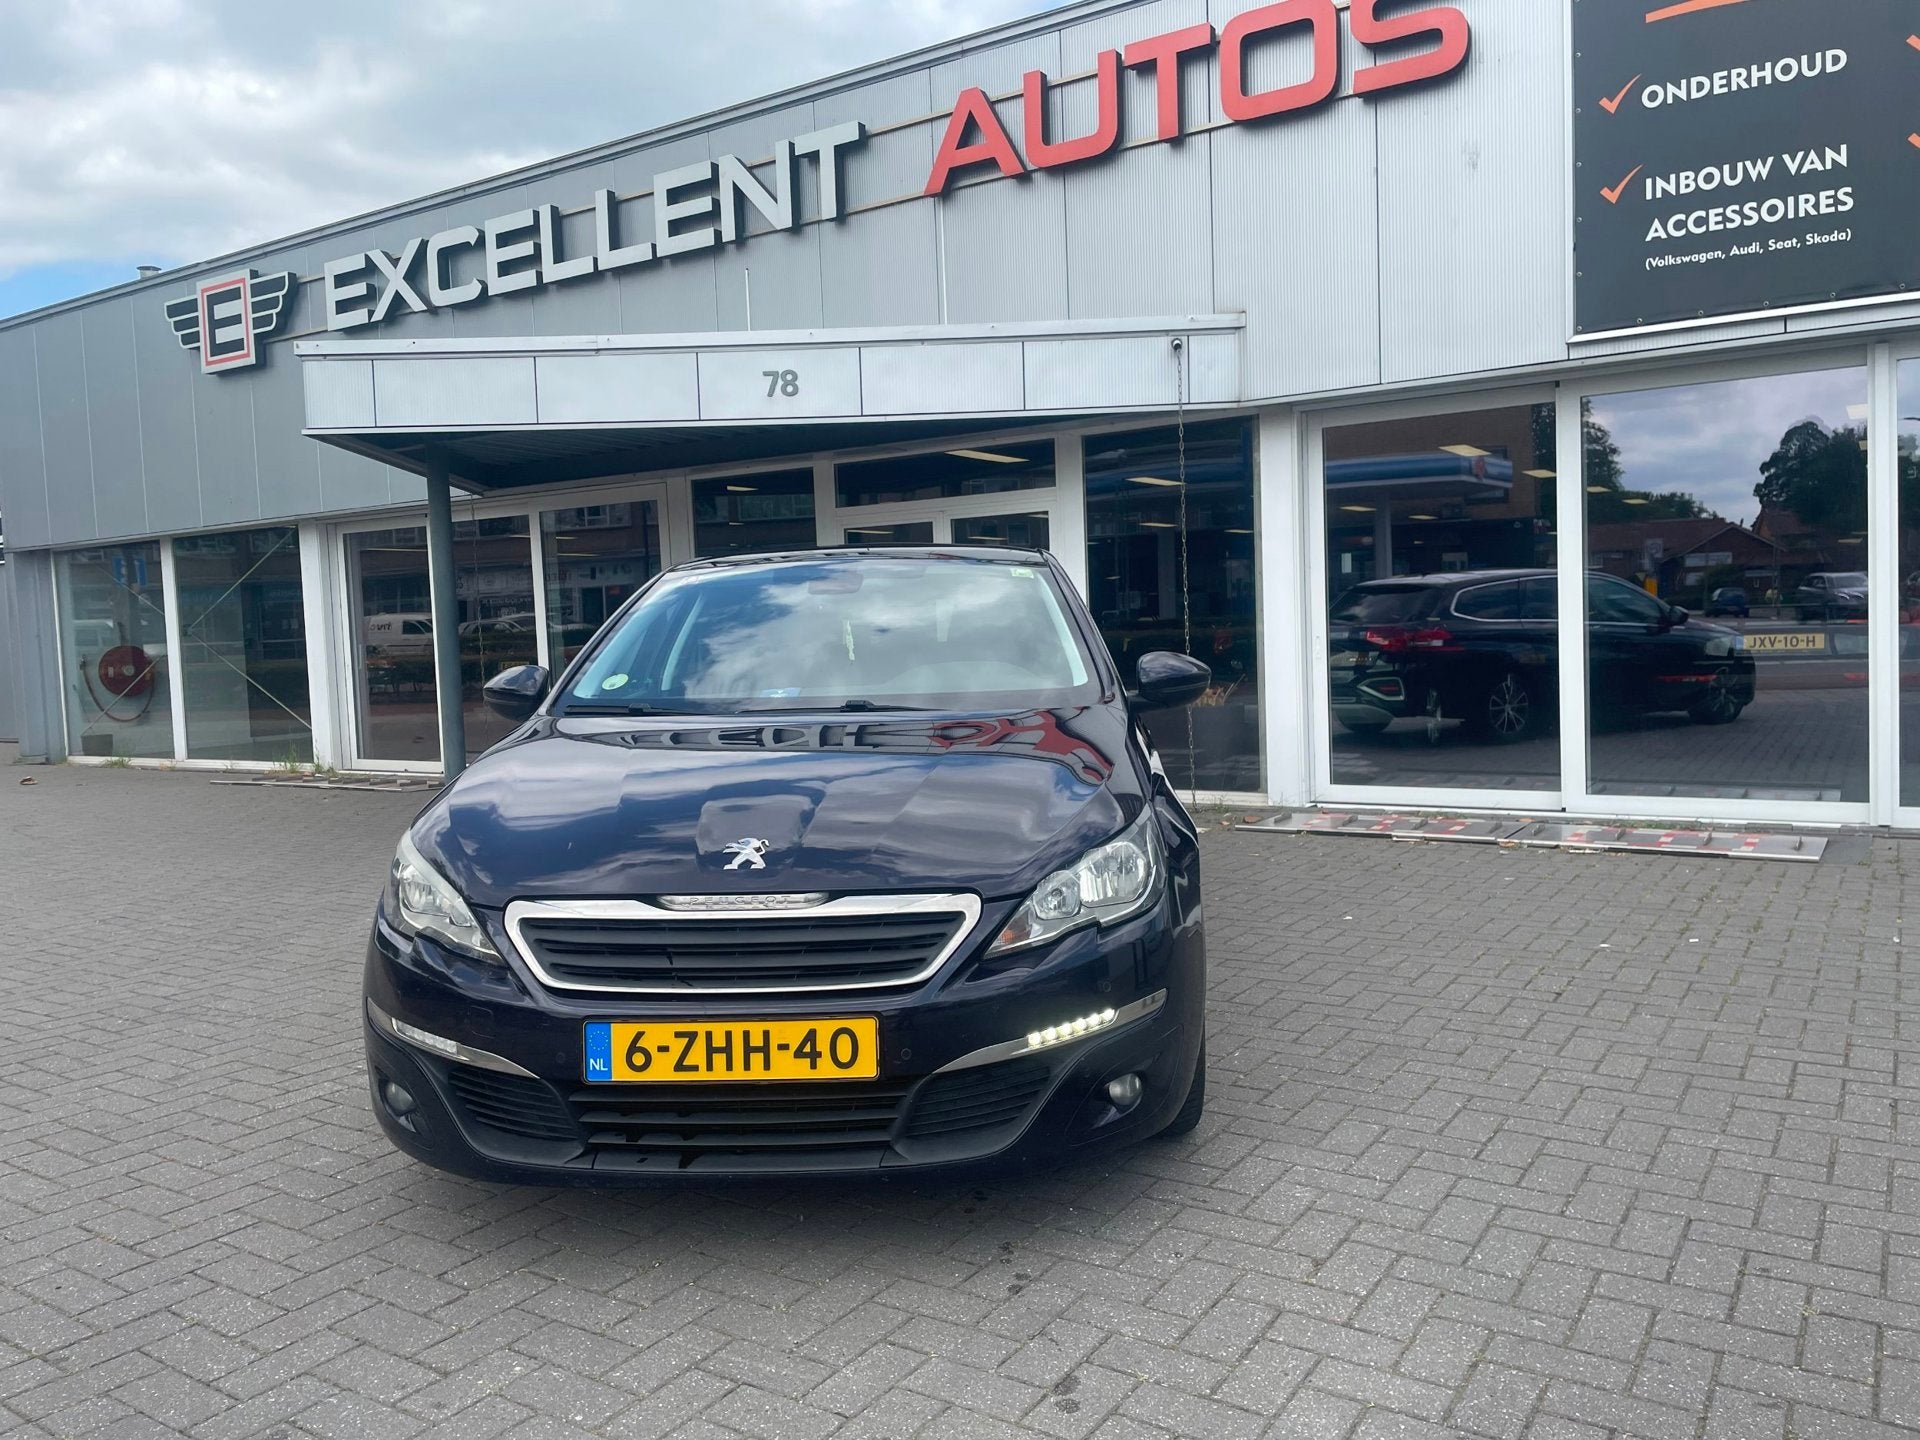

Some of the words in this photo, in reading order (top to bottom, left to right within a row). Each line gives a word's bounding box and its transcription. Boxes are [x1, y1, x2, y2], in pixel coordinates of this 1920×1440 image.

[1641, 48, 1848, 108] ONDERHOUD
[324, 120, 866, 332] EXCELLENT
[923, 0, 1469, 196] AUTOS
[1645, 156, 1774, 200] INBOUW
[1782, 144, 1848, 176] VAN
[1645, 186, 1854, 241] ACCESSOIRES
[1645, 250, 1726, 270] (Volkswagen,
[1729, 241, 1764, 256] Audi,
[1768, 236, 1801, 251] Seat,
[1805, 228, 1852, 246] Skoda)
[762, 369, 799, 397] 78
[1749, 635, 1816, 649] JXV-10-H
[589, 1058, 608, 1071] NL
[625, 1026, 859, 1073] 6-ZHH-40
